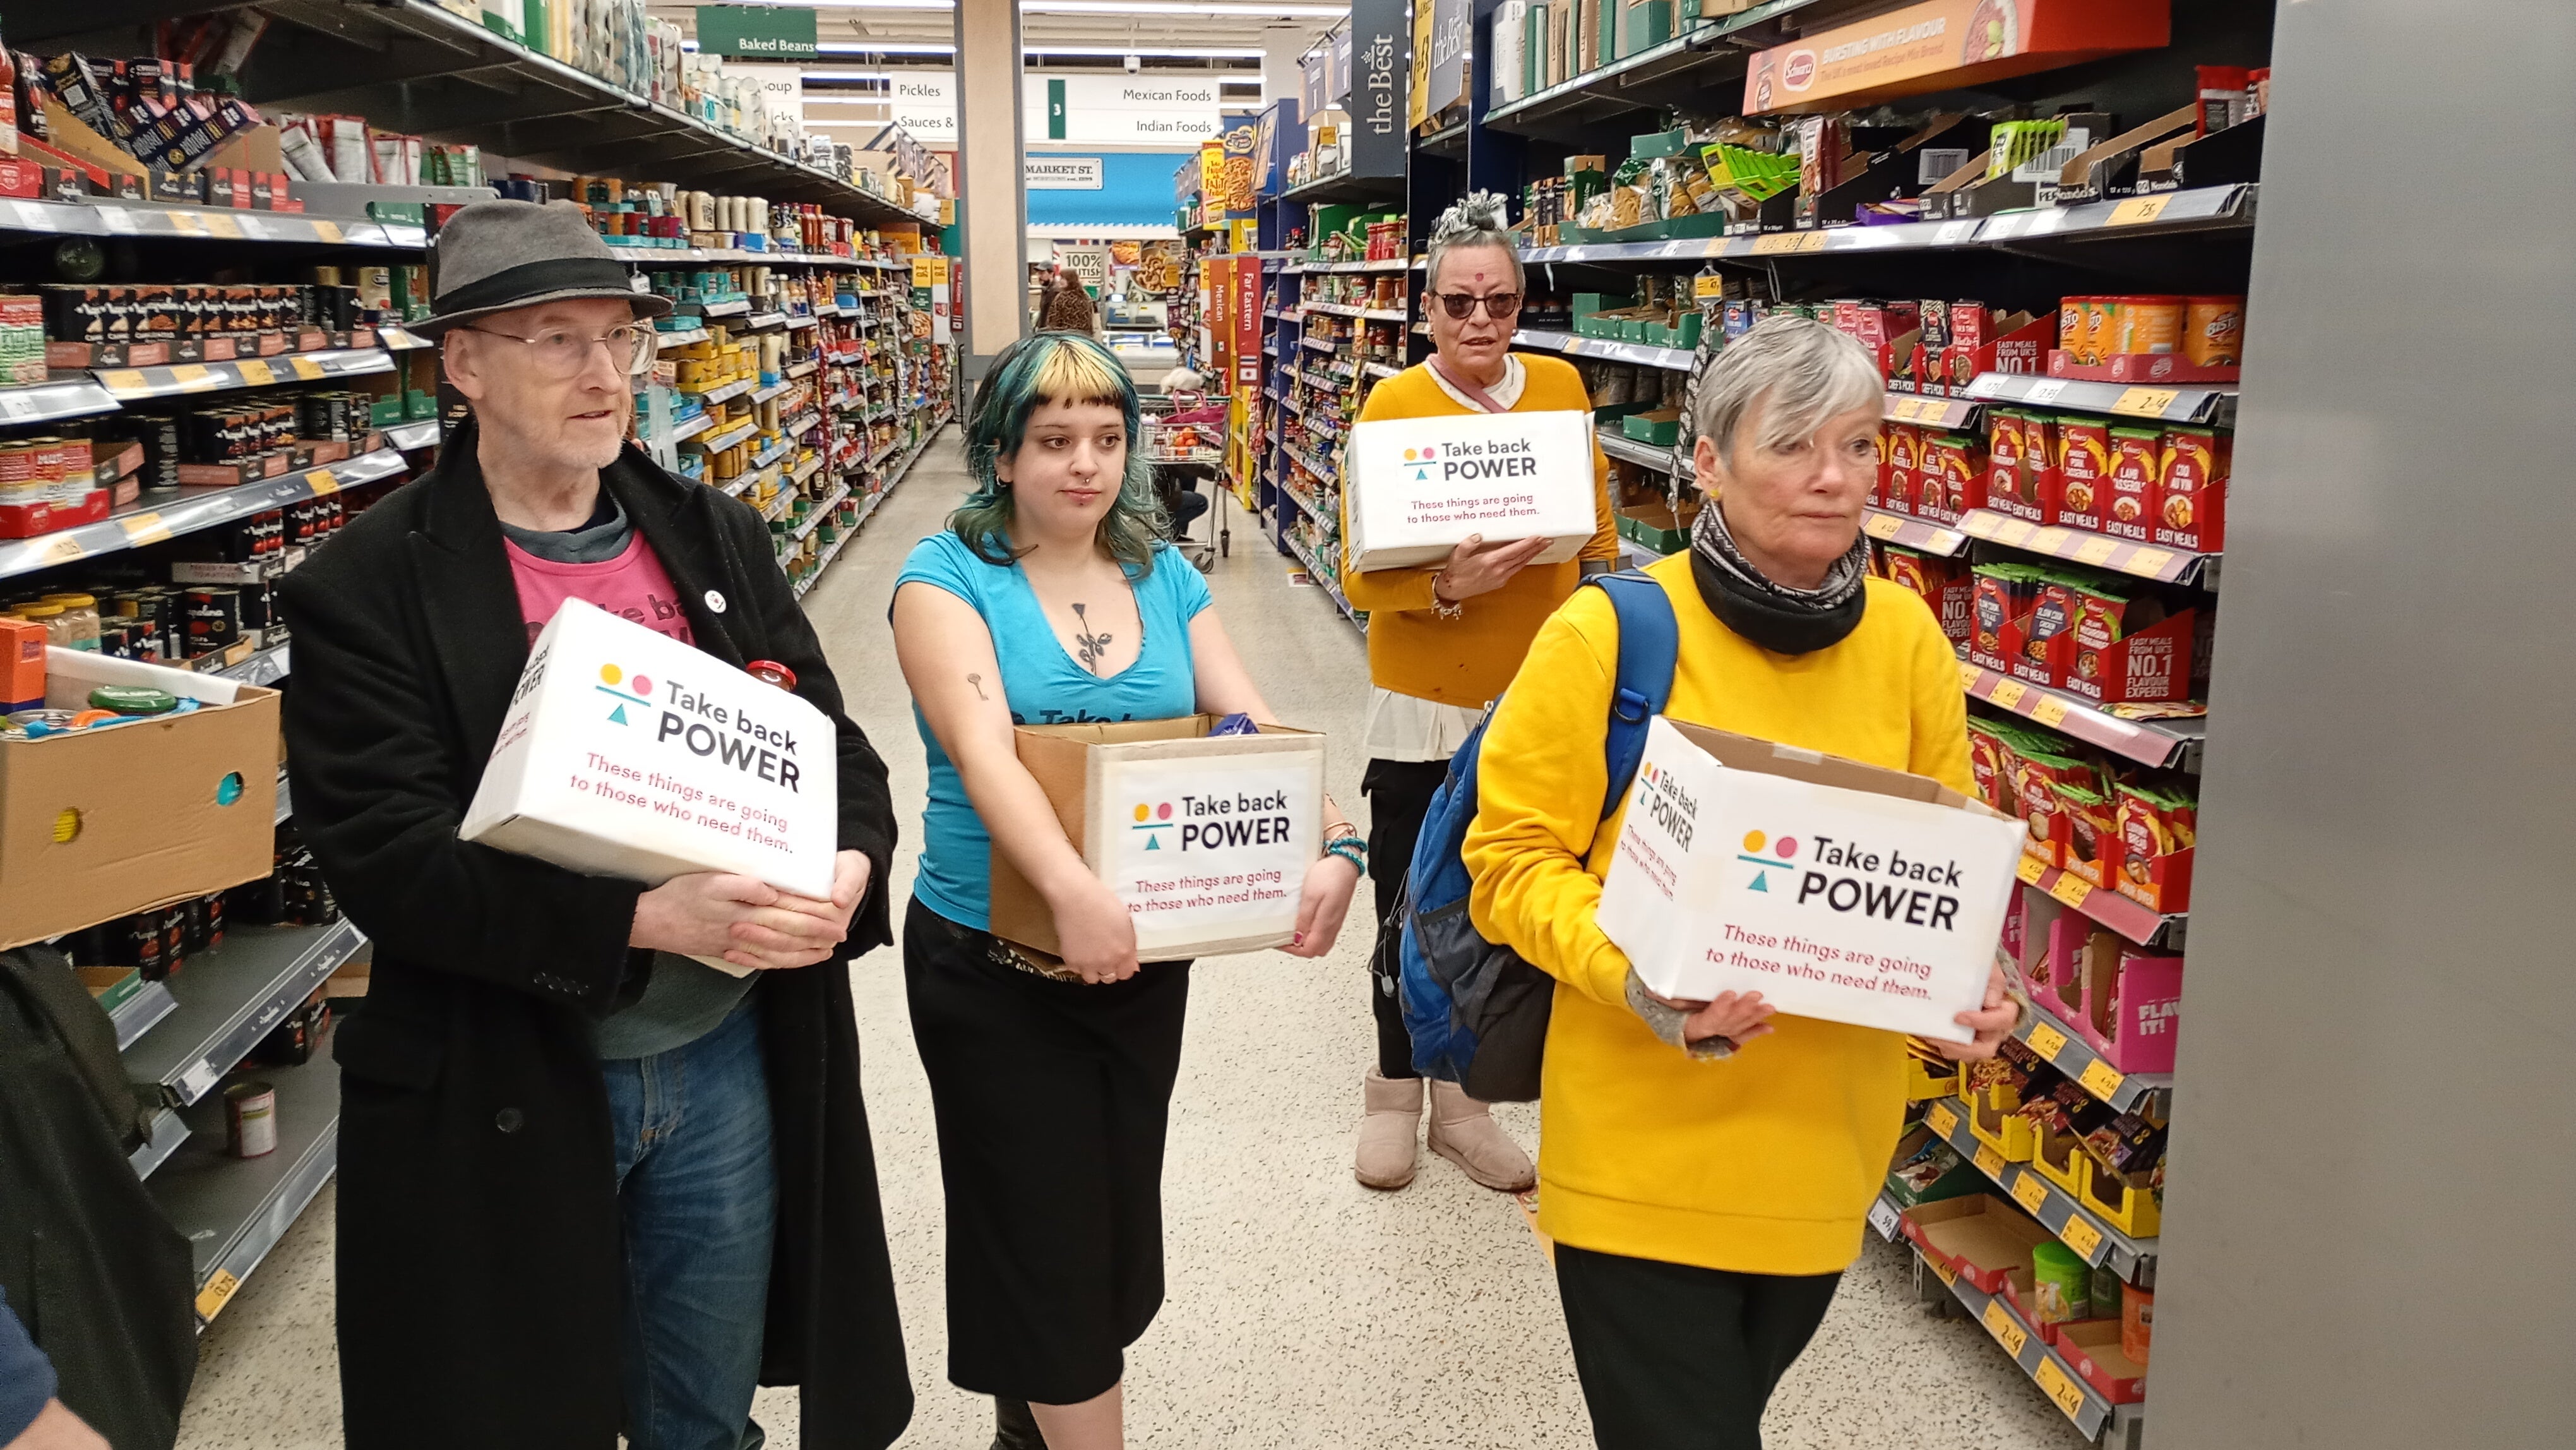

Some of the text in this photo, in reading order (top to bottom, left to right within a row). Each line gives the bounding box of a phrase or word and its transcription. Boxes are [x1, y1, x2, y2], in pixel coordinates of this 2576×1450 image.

[739, 38, 816, 52] Baked Beans
[1822, 17, 1946, 65] BURSTING WITH FLAVOUR
[765, 82, 792, 93] oup
[900, 84, 941, 97] Pickles
[1123, 88, 1212, 102] Mexican Foods
[1053, 104, 1061, 116] 3
[901, 116, 955, 128] Sauces &
[1136, 120, 1212, 133] Indian Foods
[1025, 165, 1076, 174] MARKET
[1215, 284, 1225, 322] Mexican
[1243, 272, 1255, 332] Far Eastern
[1996, 348, 2018, 357] FROM
[2015, 340, 2037, 349] MEALS
[1441, 438, 1532, 458] Take back
[1443, 457, 1537, 482] POWER
[1410, 493, 1534, 510] These things are going
[1407, 506, 1541, 524] to those who need them.
[2059, 510, 2099, 530] EASY MEALS
[2106, 520, 2147, 540] EASY MEALS
[2156, 528, 2198, 549] EASY MEALS
[2128, 645, 2153, 655] FROM
[2130, 637, 2173, 646] EASY MEALS
[2127, 654, 2174, 677] NO.1
[2126, 676, 2169, 688] FLAVOUR
[2125, 687, 2169, 698] EXPERTS
[665, 679, 798, 756] Take back
[657, 711, 801, 794] POWER
[586, 752, 789, 834] These things are going
[1181, 789, 1288, 817] Take back
[1659, 769, 1698, 820] Take back
[569, 774, 794, 854] to those who need them.
[1650, 793, 1693, 853] POWER
[1181, 817, 1291, 851] POWER
[1813, 836, 1965, 889] Take back
[1135, 868, 1282, 894] These things are going
[1128, 886, 1287, 913] to those who need them.
[1797, 870, 1960, 933] POWER
[1724, 923, 1933, 980] These things are going
[1704, 948, 1933, 1001] to those who need them.
[2140, 1019, 2166, 1036] IT!
